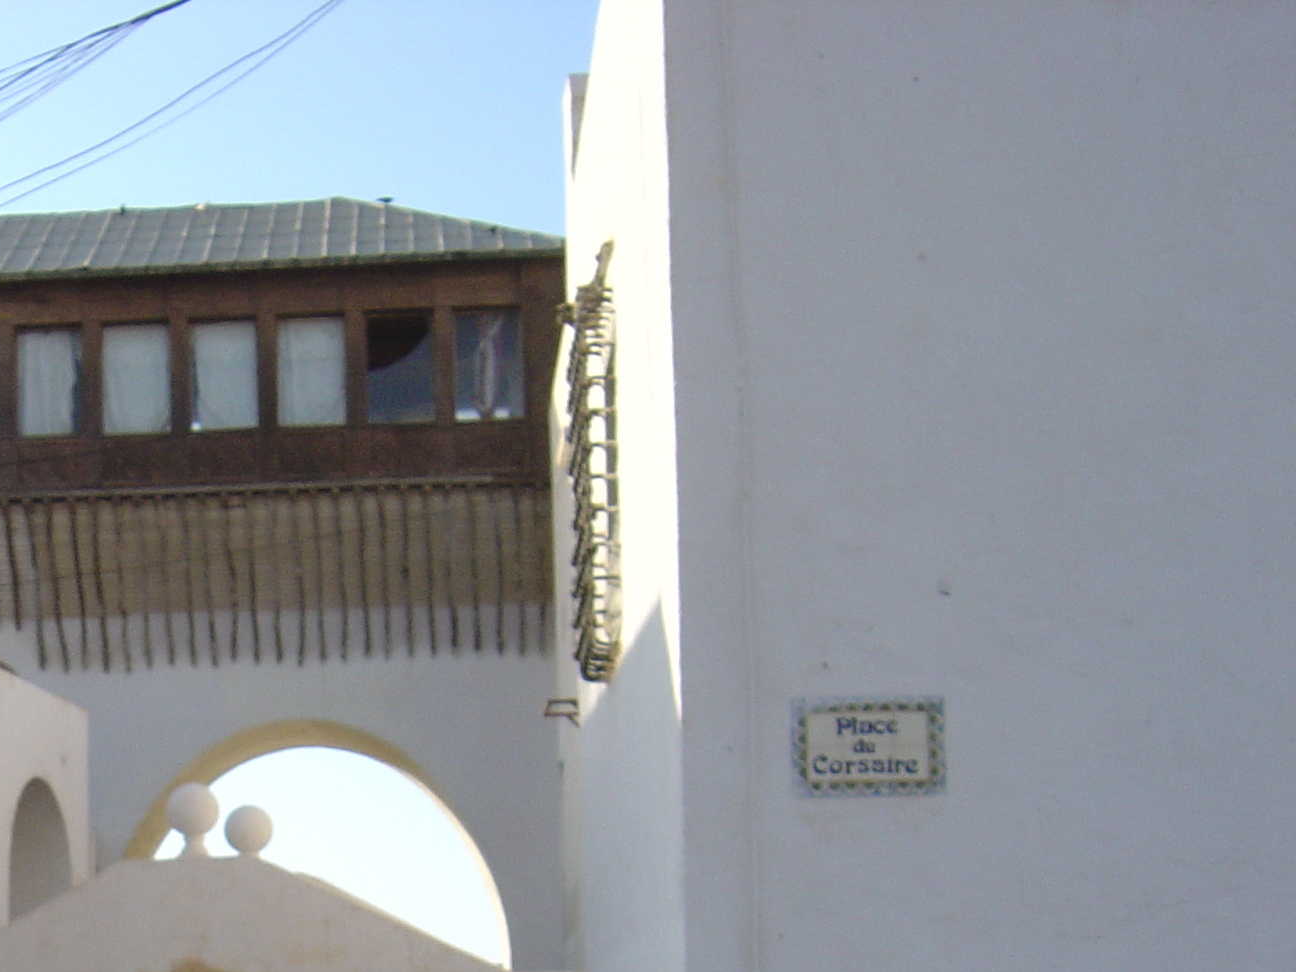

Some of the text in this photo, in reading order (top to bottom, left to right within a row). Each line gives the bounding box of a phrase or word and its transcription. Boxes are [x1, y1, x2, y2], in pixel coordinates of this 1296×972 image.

[836, 716, 898, 735] Place
[853, 738, 876, 753] du
[813, 754, 919, 774] Corsaire
